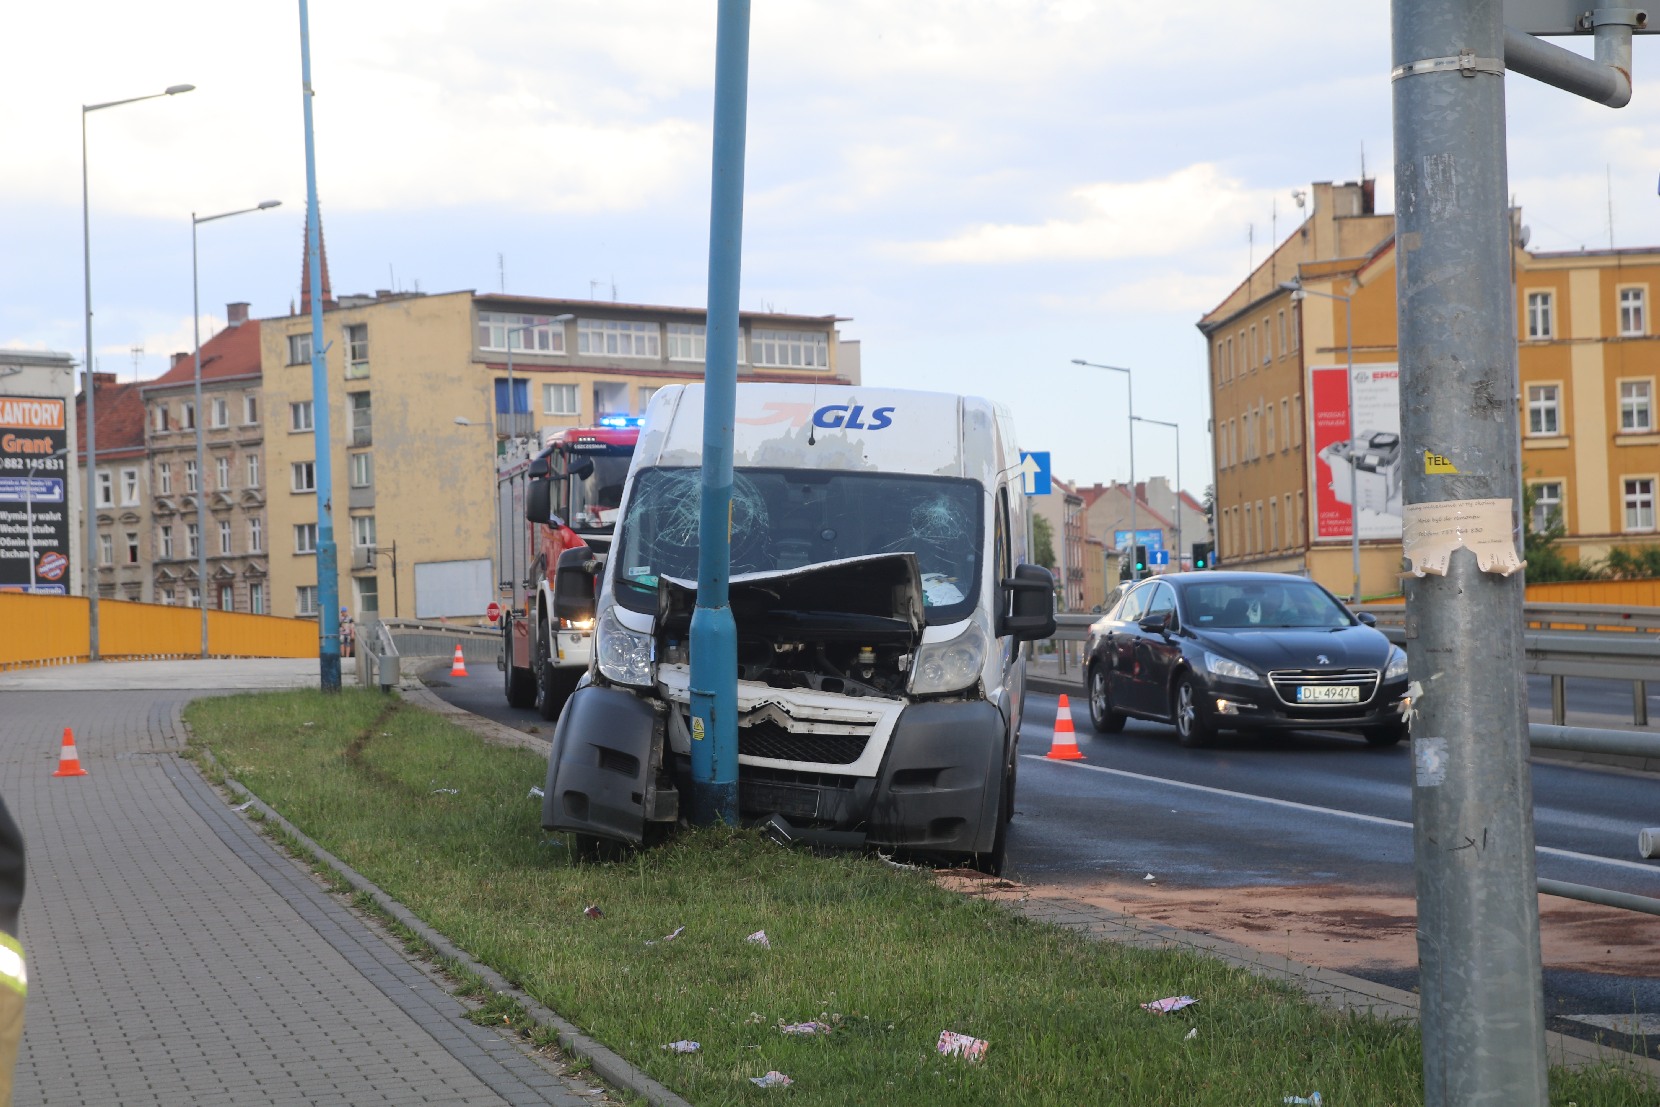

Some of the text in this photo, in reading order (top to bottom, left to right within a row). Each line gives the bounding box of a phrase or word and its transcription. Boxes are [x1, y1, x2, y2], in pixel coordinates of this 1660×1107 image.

[1372, 371, 1399, 379] ERG
[812, 404, 896, 431] GLS
[2, 433, 54, 455] Grant
[4, 457, 64, 470] 882 145 831
[0, 510, 62, 523] Wymiay walut
[0, 523, 56, 534] Wechsestube
[0, 548, 40, 559] Exchane
[488, 608, 499, 616] STOP
[1303, 687, 1358, 699] DL 4947C
